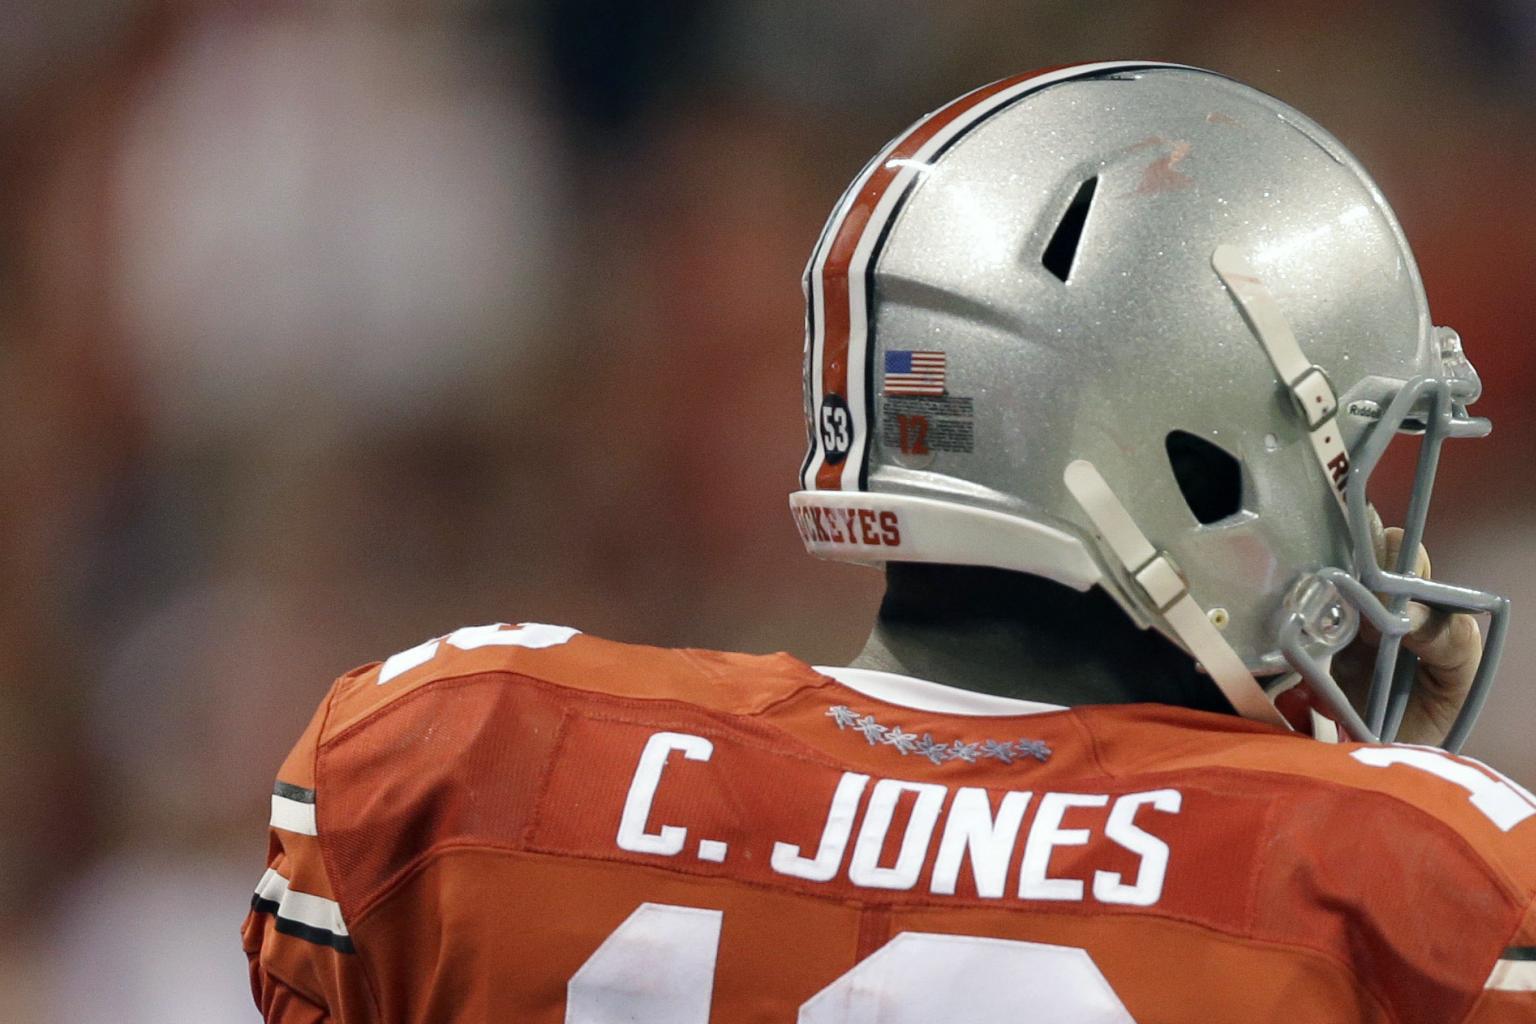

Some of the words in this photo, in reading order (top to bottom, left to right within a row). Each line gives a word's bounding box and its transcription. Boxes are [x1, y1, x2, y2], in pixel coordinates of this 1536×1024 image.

[822, 406, 849, 452] 53
[896, 414, 929, 456] 12
[616, 730, 728, 863] C.
[770, 770, 1183, 907] JONES
